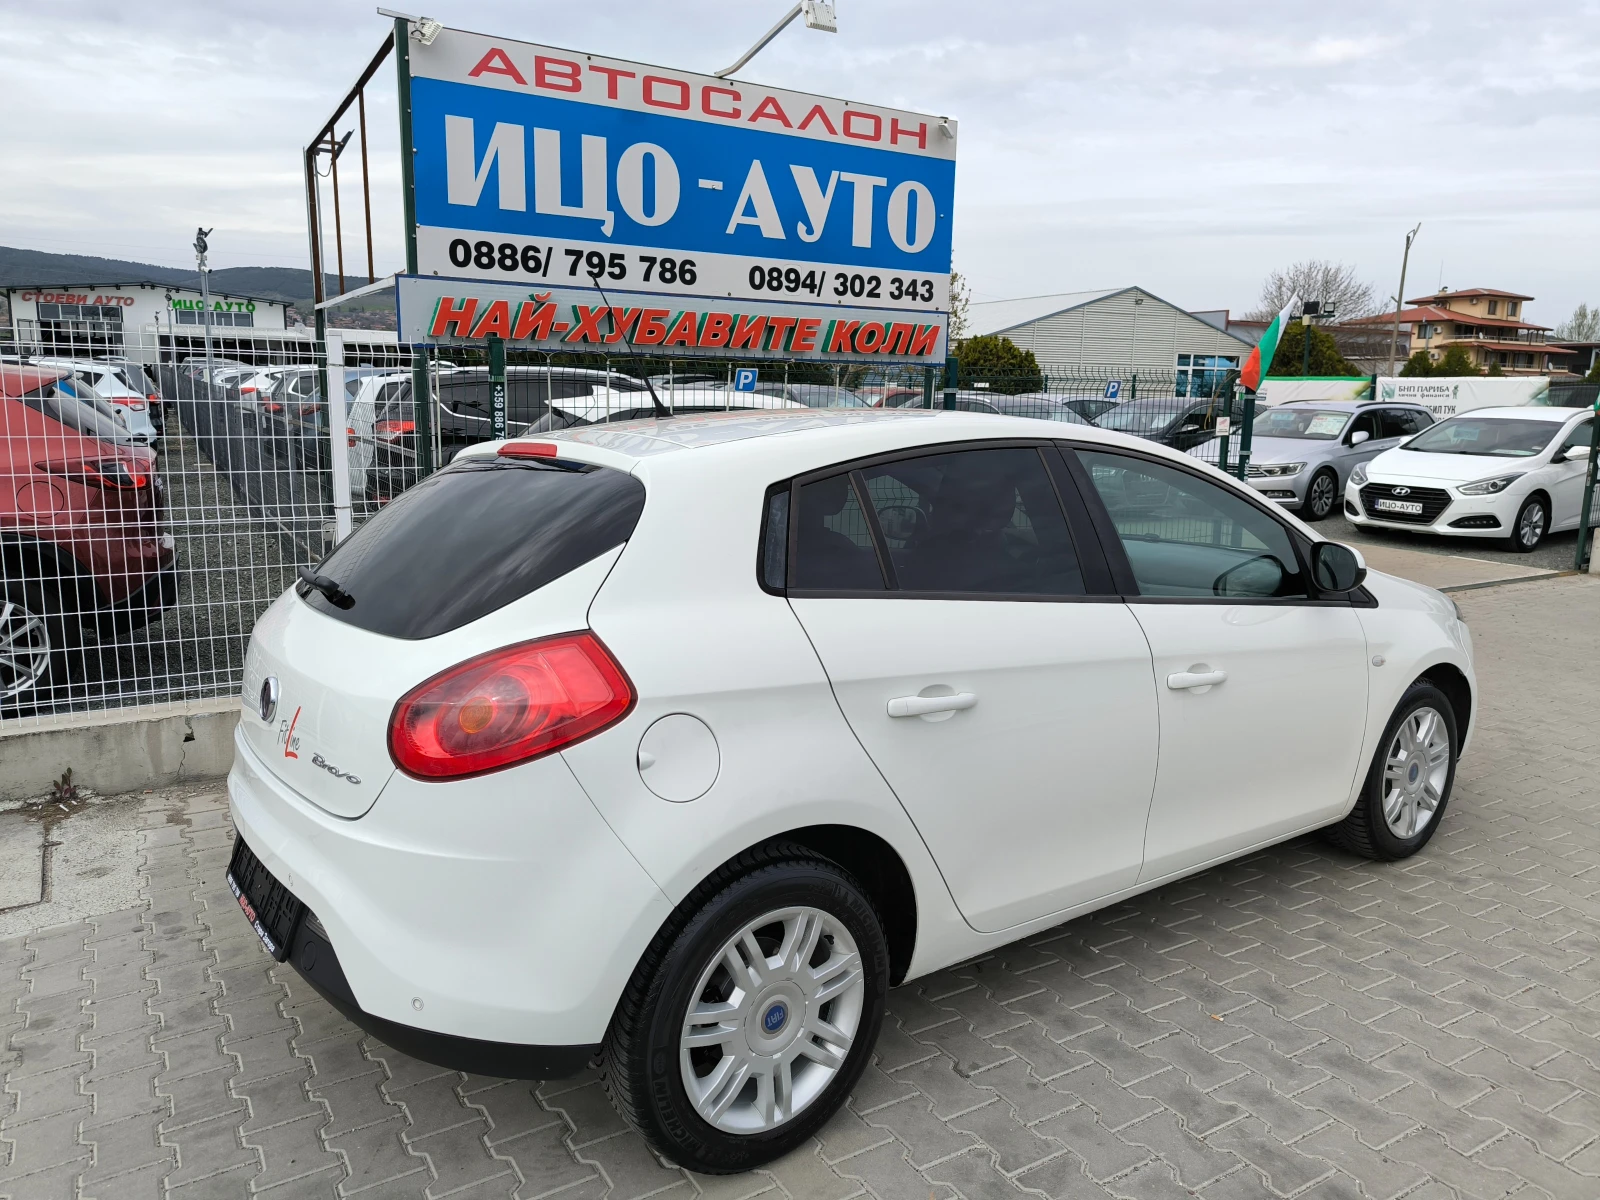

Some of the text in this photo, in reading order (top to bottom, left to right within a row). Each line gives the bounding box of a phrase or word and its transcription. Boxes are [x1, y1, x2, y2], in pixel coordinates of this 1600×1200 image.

[468, 47, 927, 149] АВТОСАЛОН
[449, 239, 697, 286] 0886/ 795 786
[749, 265, 934, 303] 0894/ 302 343
[21, 291, 135, 307] СТОЕВИ АУТО
[428, 291, 940, 357] НАЙ-ХУБАВИТЕ КОЛИ
[1398, 385, 1450, 393] БНП ПАРИБА
[494, 411, 505, 429] 886
[1379, 500, 1422, 512] ИЦО-АУТО
[766, 1008, 784, 1028] FIAT
